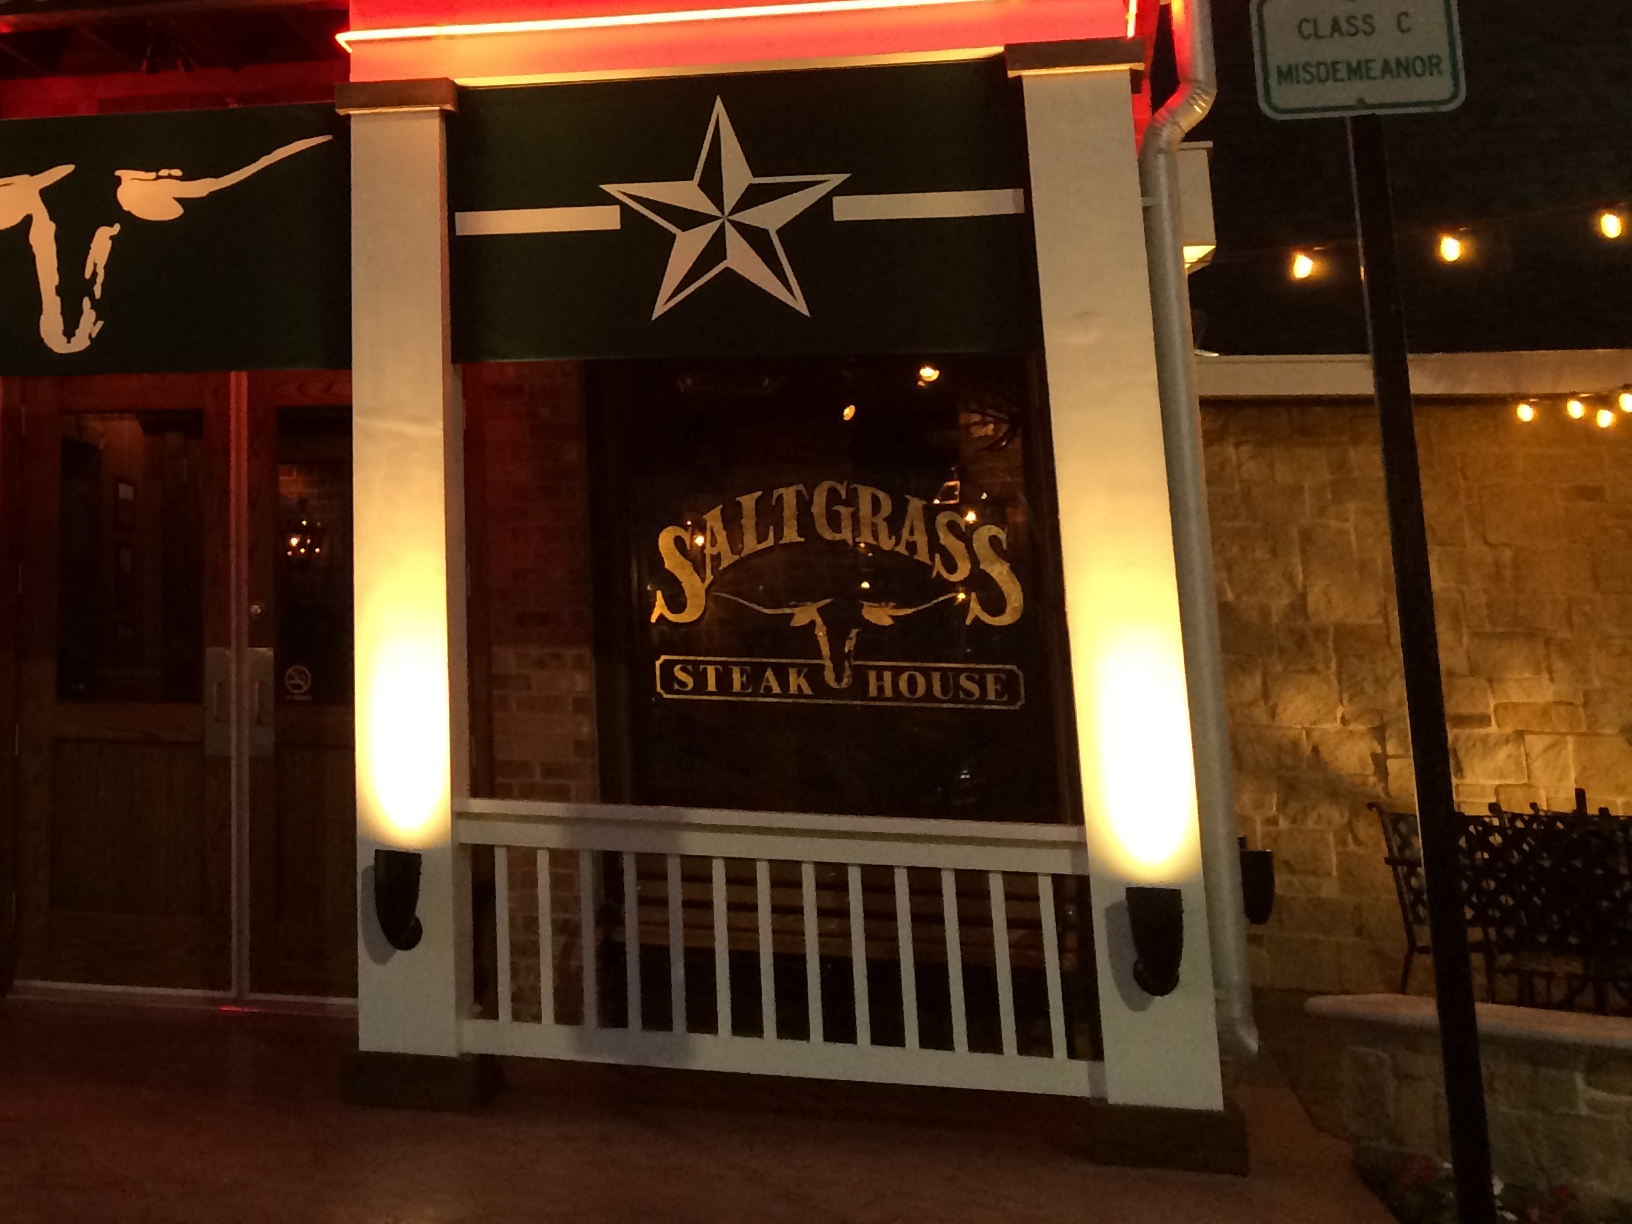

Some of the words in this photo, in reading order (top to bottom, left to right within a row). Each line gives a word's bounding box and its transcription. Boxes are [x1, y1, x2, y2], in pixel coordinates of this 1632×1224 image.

[1296, 13, 1377, 40] CLASS
[1396, 11, 1413, 34] C
[1276, 54, 1444, 87] MISDEMEANOR
[650, 480, 1024, 626] SALTGRASS
[673, 664, 814, 695] STEAK
[867, 669, 1009, 703] HOUSE
